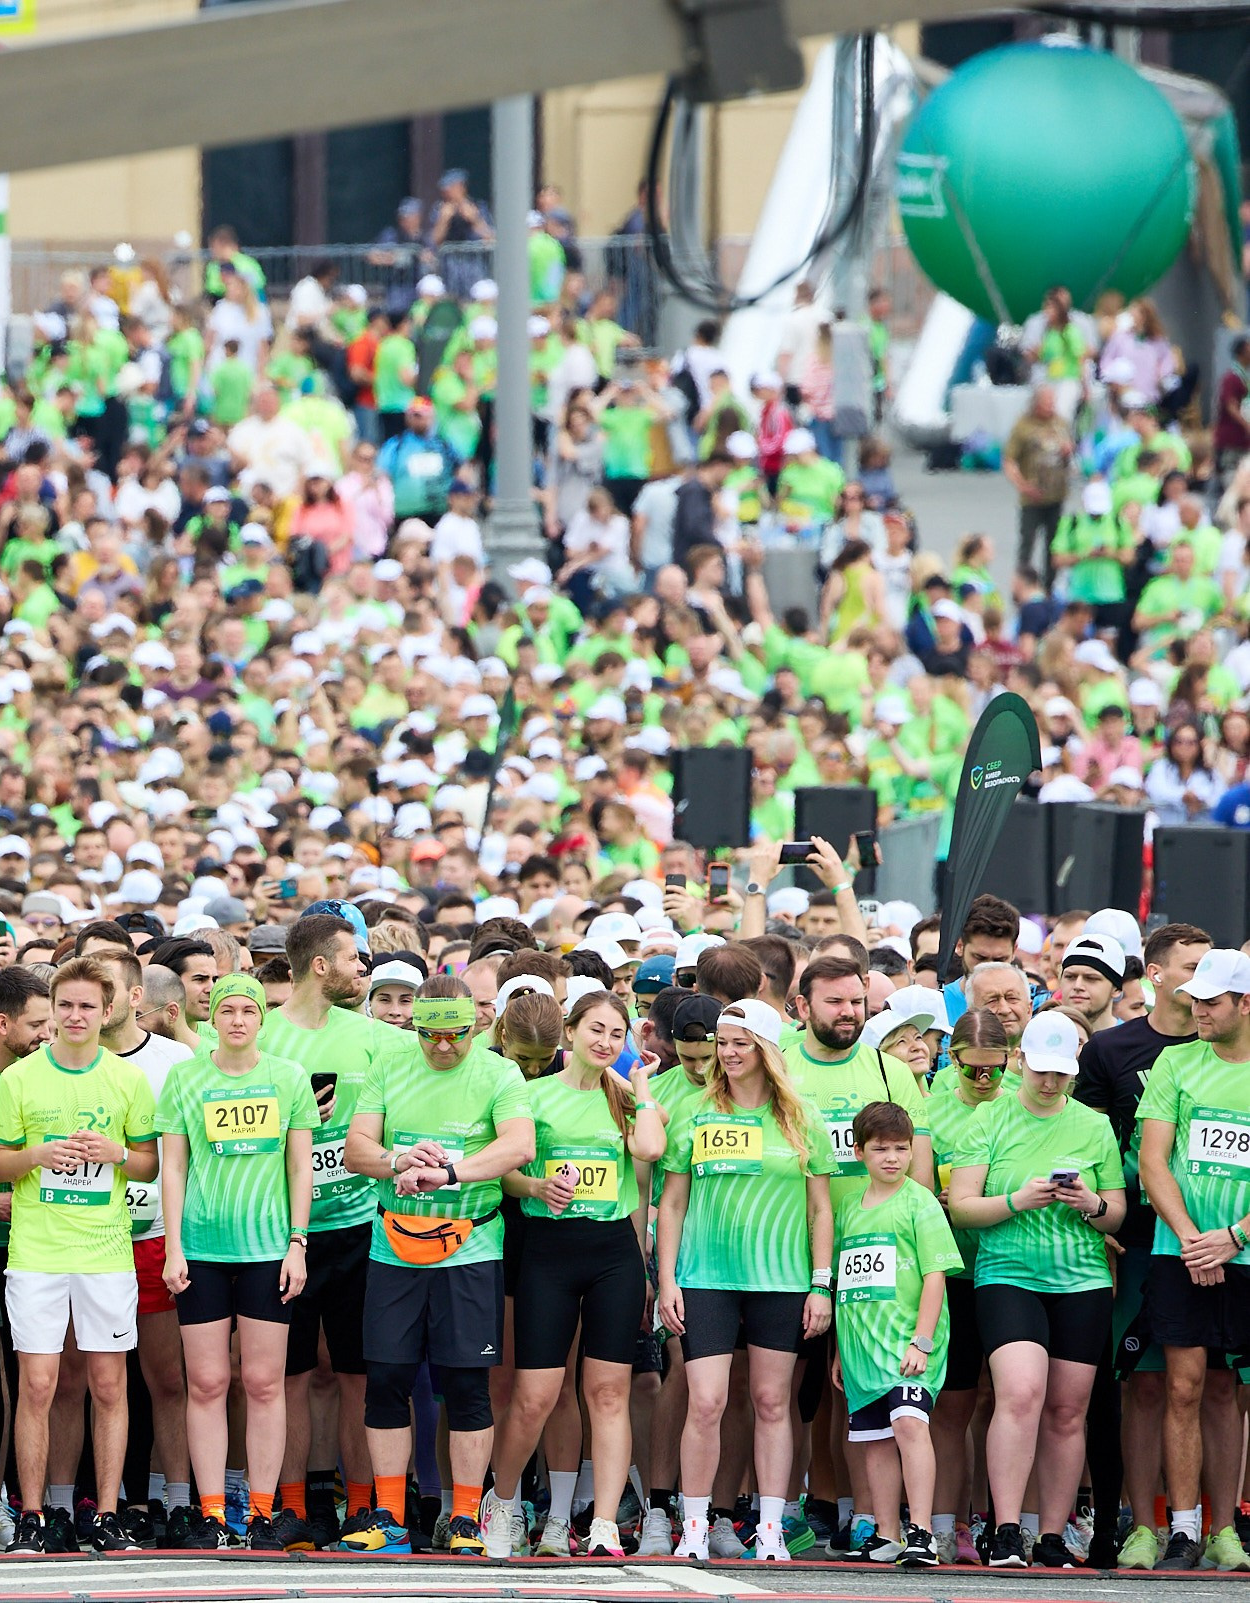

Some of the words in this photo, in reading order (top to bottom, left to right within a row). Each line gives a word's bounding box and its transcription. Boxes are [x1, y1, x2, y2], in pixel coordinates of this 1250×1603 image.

[987, 760, 1002, 770] СБЕР
[215, 1104, 269, 1128] 2107
[700, 1129, 749, 1149] 1651
[831, 1128, 854, 1149] 10
[1200, 1127, 1250, 1153] 1298
[704, 1149, 746, 1157] ЕКАТЕРИНА
[1206, 1150, 1238, 1160] АЛЕКСЕЙ
[63, 1178, 92, 1186] АНДРЕЙ
[327, 1169, 348, 1178] СЕРГЕ
[125, 1187, 149, 1207] 62
[845, 1253, 885, 1276] 6536
[903, 1386, 922, 1402] 13
